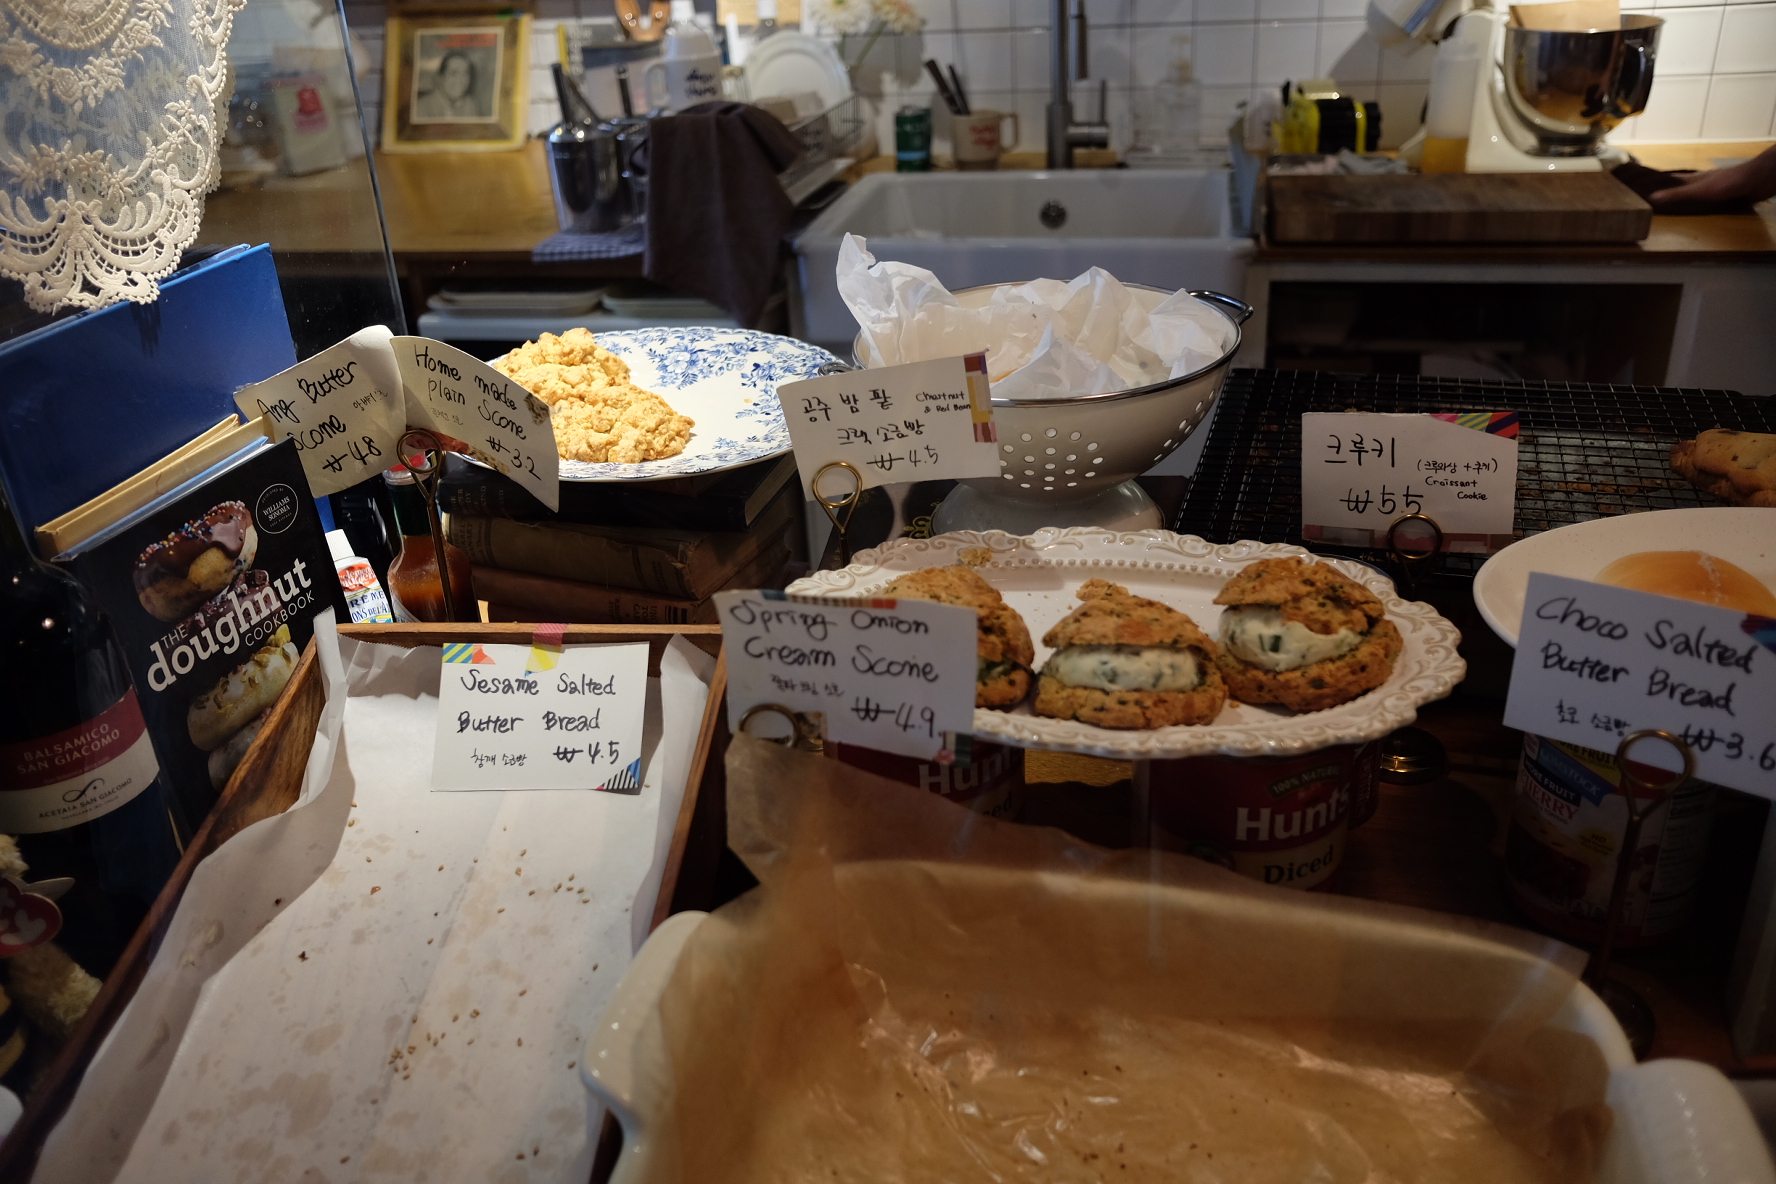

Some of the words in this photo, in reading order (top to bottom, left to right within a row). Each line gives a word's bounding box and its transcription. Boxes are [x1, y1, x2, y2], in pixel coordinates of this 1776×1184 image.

[257, 399, 300, 423] Ang
[297, 361, 357, 403] Butter
[414, 344, 461, 381] Home
[474, 375, 517, 411] made
[478, 399, 526, 440] Scone
[802, 396, 831, 422] 공주
[840, 393, 860, 413] 밤
[936, 404, 950, 412] Red
[953, 403, 971, 411] Bean
[877, 419, 925, 442] 소금빵
[1324, 432, 1396, 468] 크루키
[1425, 476, 1478, 487] Croissant
[1457, 491, 1488, 501] Cookie
[263, 496, 290, 516] WILLIAMS
[267, 505, 290, 521] SONOMA
[147, 557, 312, 692] doughnut
[161, 623, 189, 649] THE
[245, 590, 315, 647] COOKBOOK
[730, 600, 837, 641] Spring
[851, 609, 929, 635] Onion
[1536, 597, 1629, 640] Choco
[1645, 620, 1758, 674] Salted
[744, 636, 836, 667] Cream
[852, 644, 939, 683] Scone
[1541, 639, 1629, 683] Butter
[1647, 666, 1736, 716] Bread
[460, 669, 539, 695] Sesame
[557, 672, 616, 696] Salted
[457, 710, 524, 733] Butter
[542, 708, 601, 732] Bread
[17, 760, 49, 775] SAN
[54, 729, 120, 766] GIACOMO
[24, 723, 109, 762] BALSAMICO
[502, 753, 527, 766] 소금빵
[38, 805, 77, 819] ACETAIA
[80, 797, 97, 808] SAN
[99, 778, 132, 800] GIACOMO
[1272, 774, 1300, 793] 100%
[1544, 777, 1576, 801] FRUIT
[1264, 844, 1334, 884] Diced
